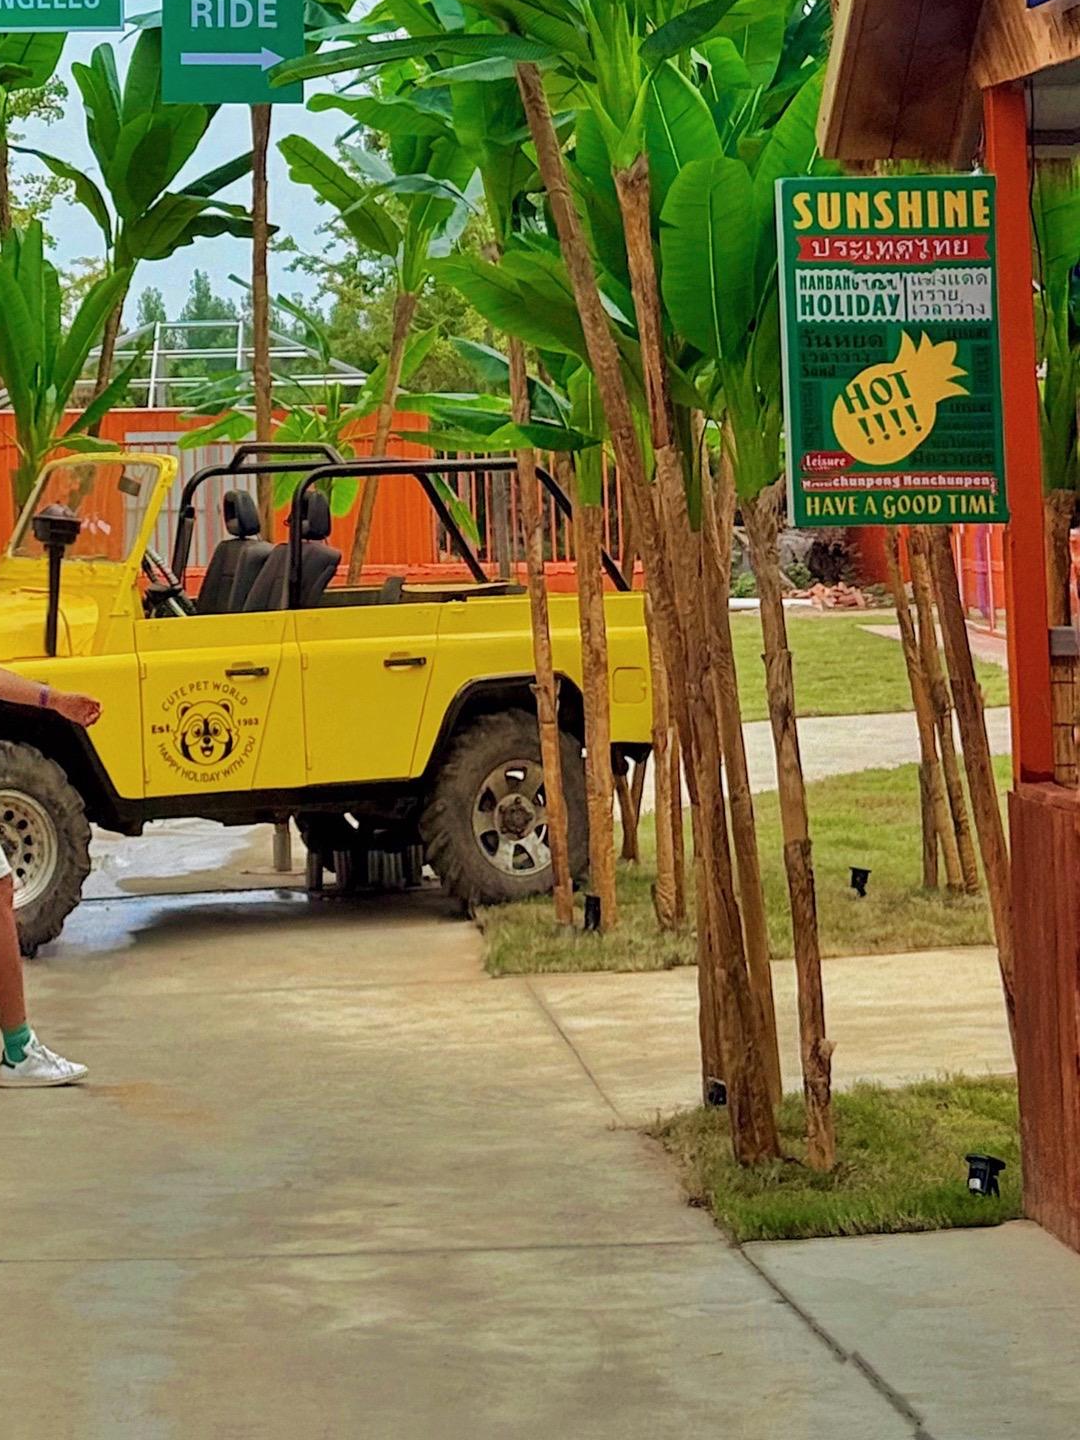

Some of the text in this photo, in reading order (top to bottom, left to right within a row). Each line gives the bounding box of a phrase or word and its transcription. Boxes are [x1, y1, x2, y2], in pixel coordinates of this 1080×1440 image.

[792, 190, 990, 230] SUNSHINE
[800, 294, 900, 316] HOLIDAY
[840, 370, 910, 414] HOT
[806, 494, 999, 519] HAVE A GOOD TIME
[161, 680, 249, 712] CUTE PET WORLD
[157, 735, 257, 782] HAPPY HOLIDAY WITH YOU
